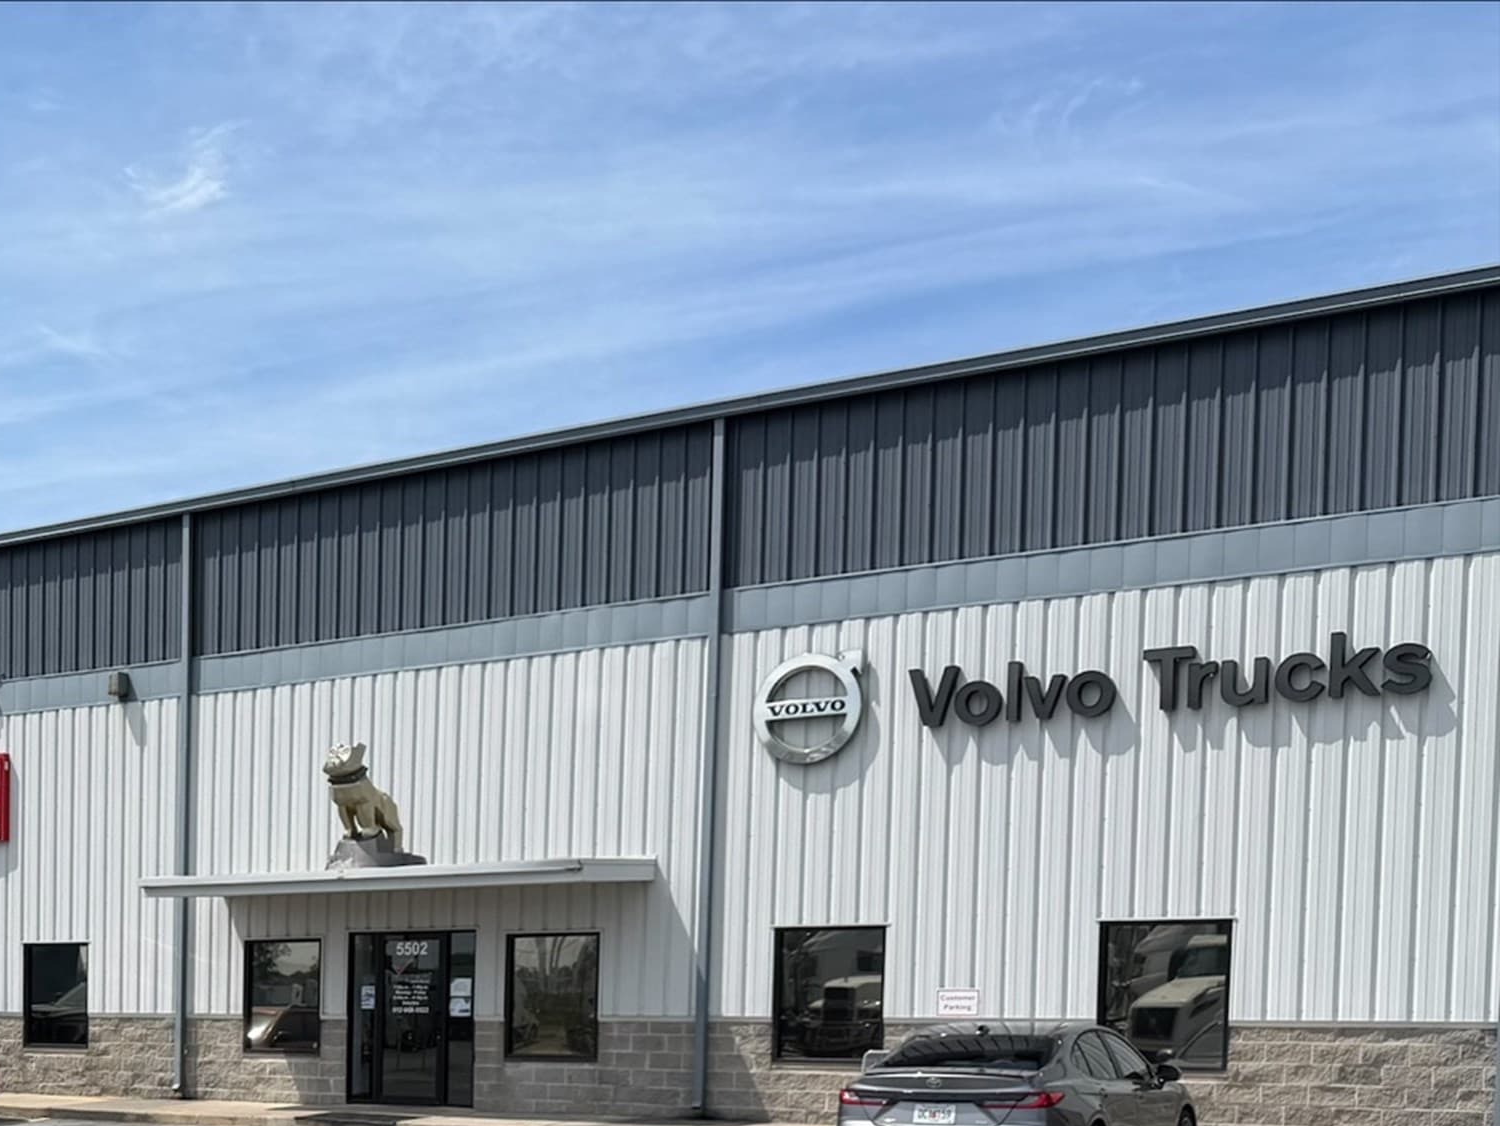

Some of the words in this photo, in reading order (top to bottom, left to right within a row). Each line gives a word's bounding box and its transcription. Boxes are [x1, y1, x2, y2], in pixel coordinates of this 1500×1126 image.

[908, 659, 1116, 728] Volvo
[1143, 631, 1433, 711] Trucks
[767, 699, 846, 717] VOLVO
[396, 941, 429, 956] 5502
